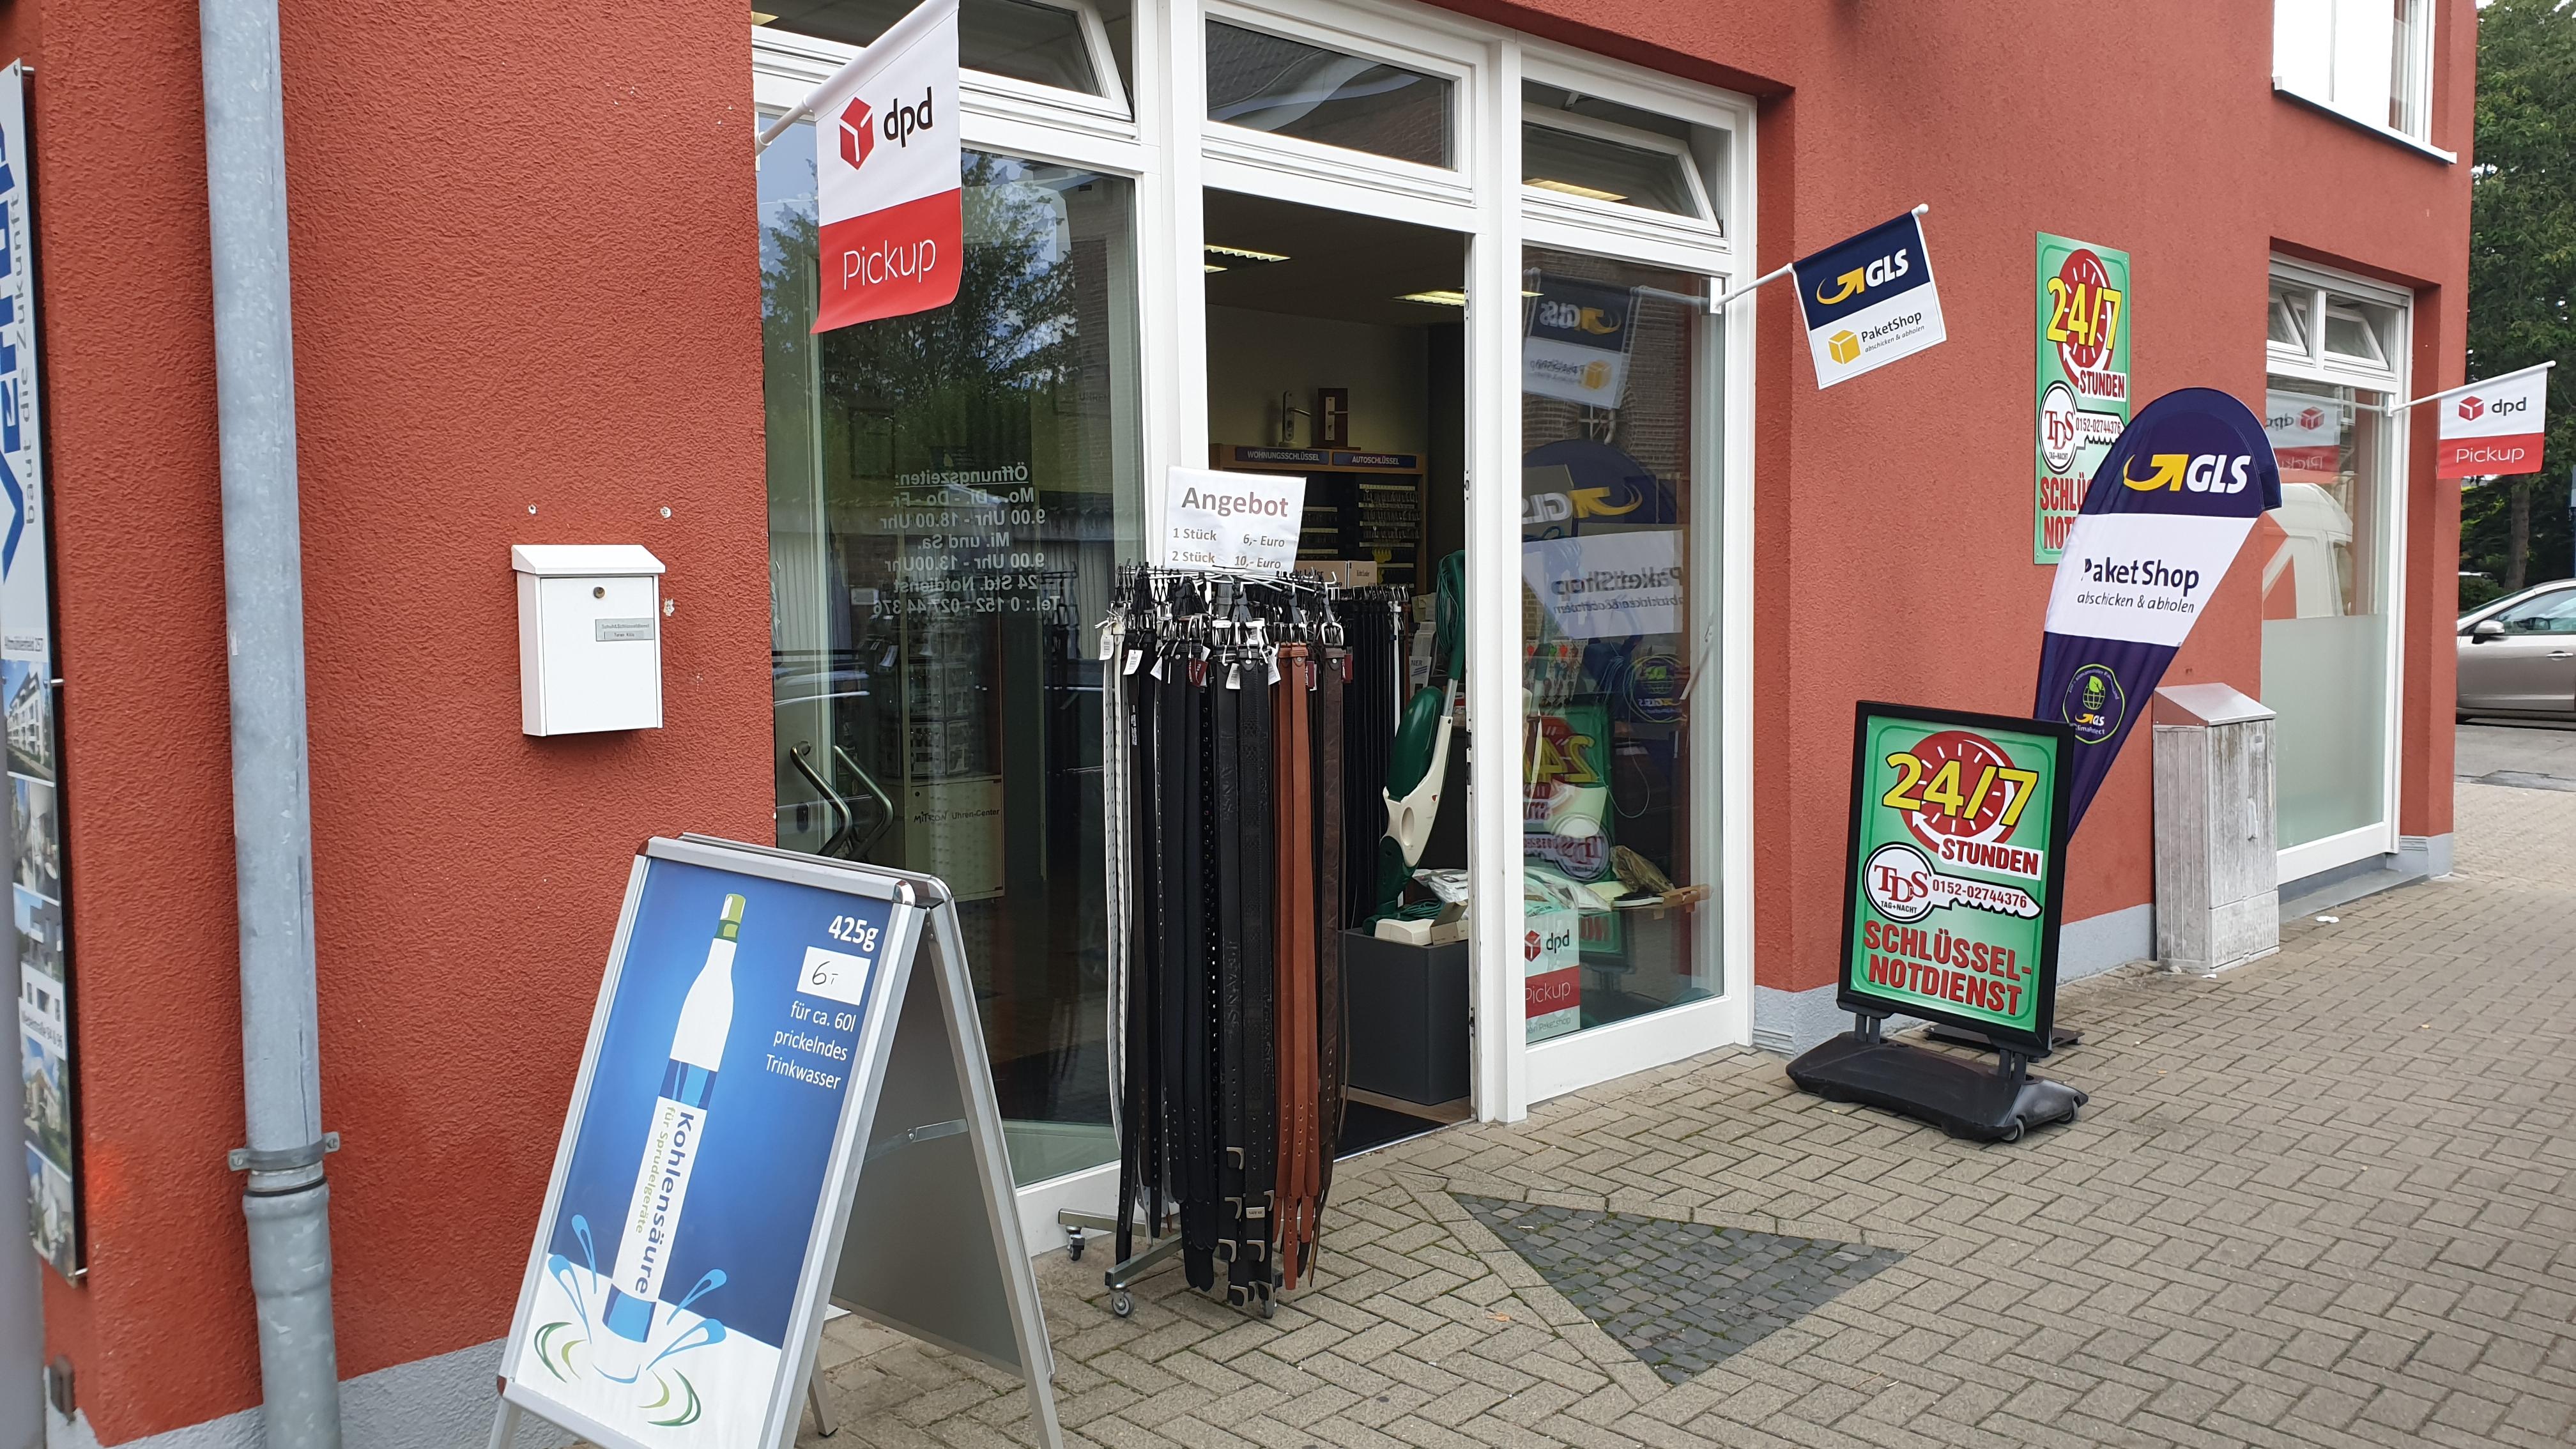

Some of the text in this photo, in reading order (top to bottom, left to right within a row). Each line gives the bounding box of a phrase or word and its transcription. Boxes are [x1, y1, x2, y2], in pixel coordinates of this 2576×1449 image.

[884, 86, 933, 148] dpd
[10, 193, 27, 352] Zukunft
[844, 240, 936, 290] Pickup
[1866, 249, 1909, 288] GLS
[1861, 312, 1922, 342] PaketShop
[2046, 276, 2122, 350] 24/7
[1865, 337, 1894, 353] abschicken
[1902, 325, 1924, 337] abholen
[19, 367, 30, 422] die
[2080, 370, 2125, 398] STUNDEN
[2491, 397, 2527, 413] dpd
[2045, 411, 2121, 449] TDS 0152-02744376
[1247, 450, 1319, 461] WOHNUNGSSCHLÜSSEL
[1352, 455, 1399, 465] AUTOSCHLÜSSEL
[2456, 447, 2525, 464] Pickup
[24, 439, 34, 524] baut
[2186, 454, 2251, 494] GLS
[1182, 487, 1289, 517] Angebot
[1173, 528, 1285, 548] 1 Stück 6,- Euro
[1172, 551, 1281, 569] 2 Stück 10,- Euro
[2077, 591, 2195, 613] abschicken & abholen
[1882, 752, 2039, 827] 24/7
[951, 809, 1000, 820] Uhren-Center
[1941, 838, 2039, 875] STUNDEN
[1874, 865, 2027, 908] TDS 0152-02744376
[1880, 900, 1917, 914] TAG+NACHT
[828, 915, 879, 953] 425g
[1546, 929, 1570, 954] dpd
[1864, 920, 2032, 981] SCHLÜSSEL-
[1868, 954, 2022, 1015] NOTDIENST
[790, 1000, 811, 1021] für
[813, 1010, 830, 1026] ca.
[773, 1030, 848, 1061] prickelndes
[766, 1054, 841, 1089] Trinkwasser
[636, 1107, 675, 1234] für Sprudelgeräte
[635, 1112, 694, 1294] Kohlensäure
